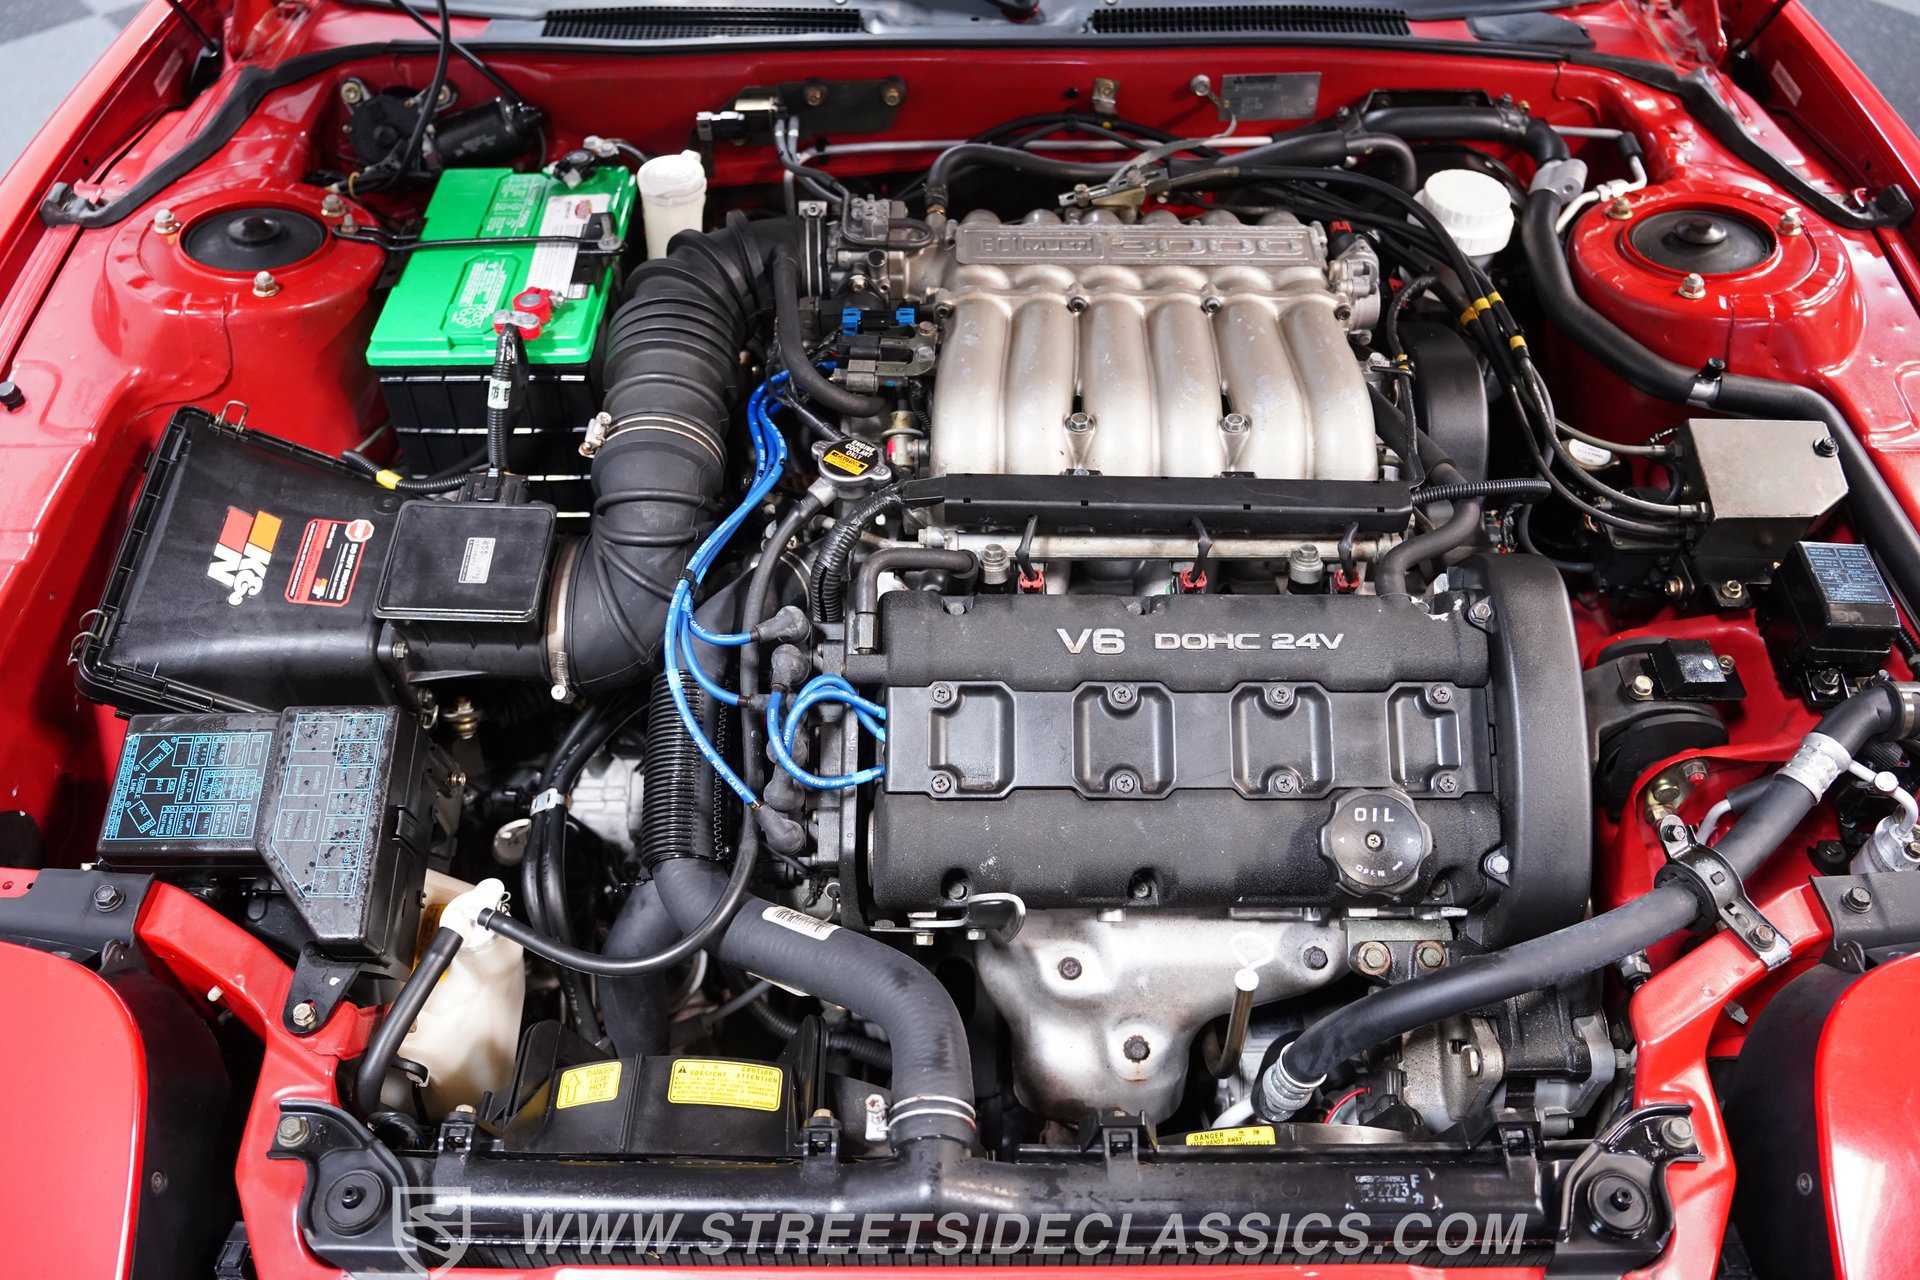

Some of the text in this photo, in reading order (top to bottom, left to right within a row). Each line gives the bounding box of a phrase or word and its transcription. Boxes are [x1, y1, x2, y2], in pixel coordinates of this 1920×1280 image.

[1024, 238, 1092, 251] MULTI
[1109, 236, 1304, 255] 3000
[845, 443, 873, 458] COOLANT
[850, 440, 876, 453] ENGINE
[845, 450, 863, 460] ONLY
[1046, 628, 1345, 655] V6 DOHC 24V
[682, 712, 695, 733] NGK
[693, 735, 712, 757] SPARK
[361, 744, 369, 761] HORN
[128, 778, 137, 793] LINK
[133, 772, 146, 798] FUSIBLE
[1354, 808, 1395, 822] OIL
[1355, 864, 1386, 877] OPEN
[586, 1066, 615, 1077] DANGER
[741, 1066, 773, 1076] CAUTION
[736, 1073, 778, 1083] ATTENTION
[589, 1082, 608, 1091] HOT
[1194, 1132, 1224, 1142] DANGER
